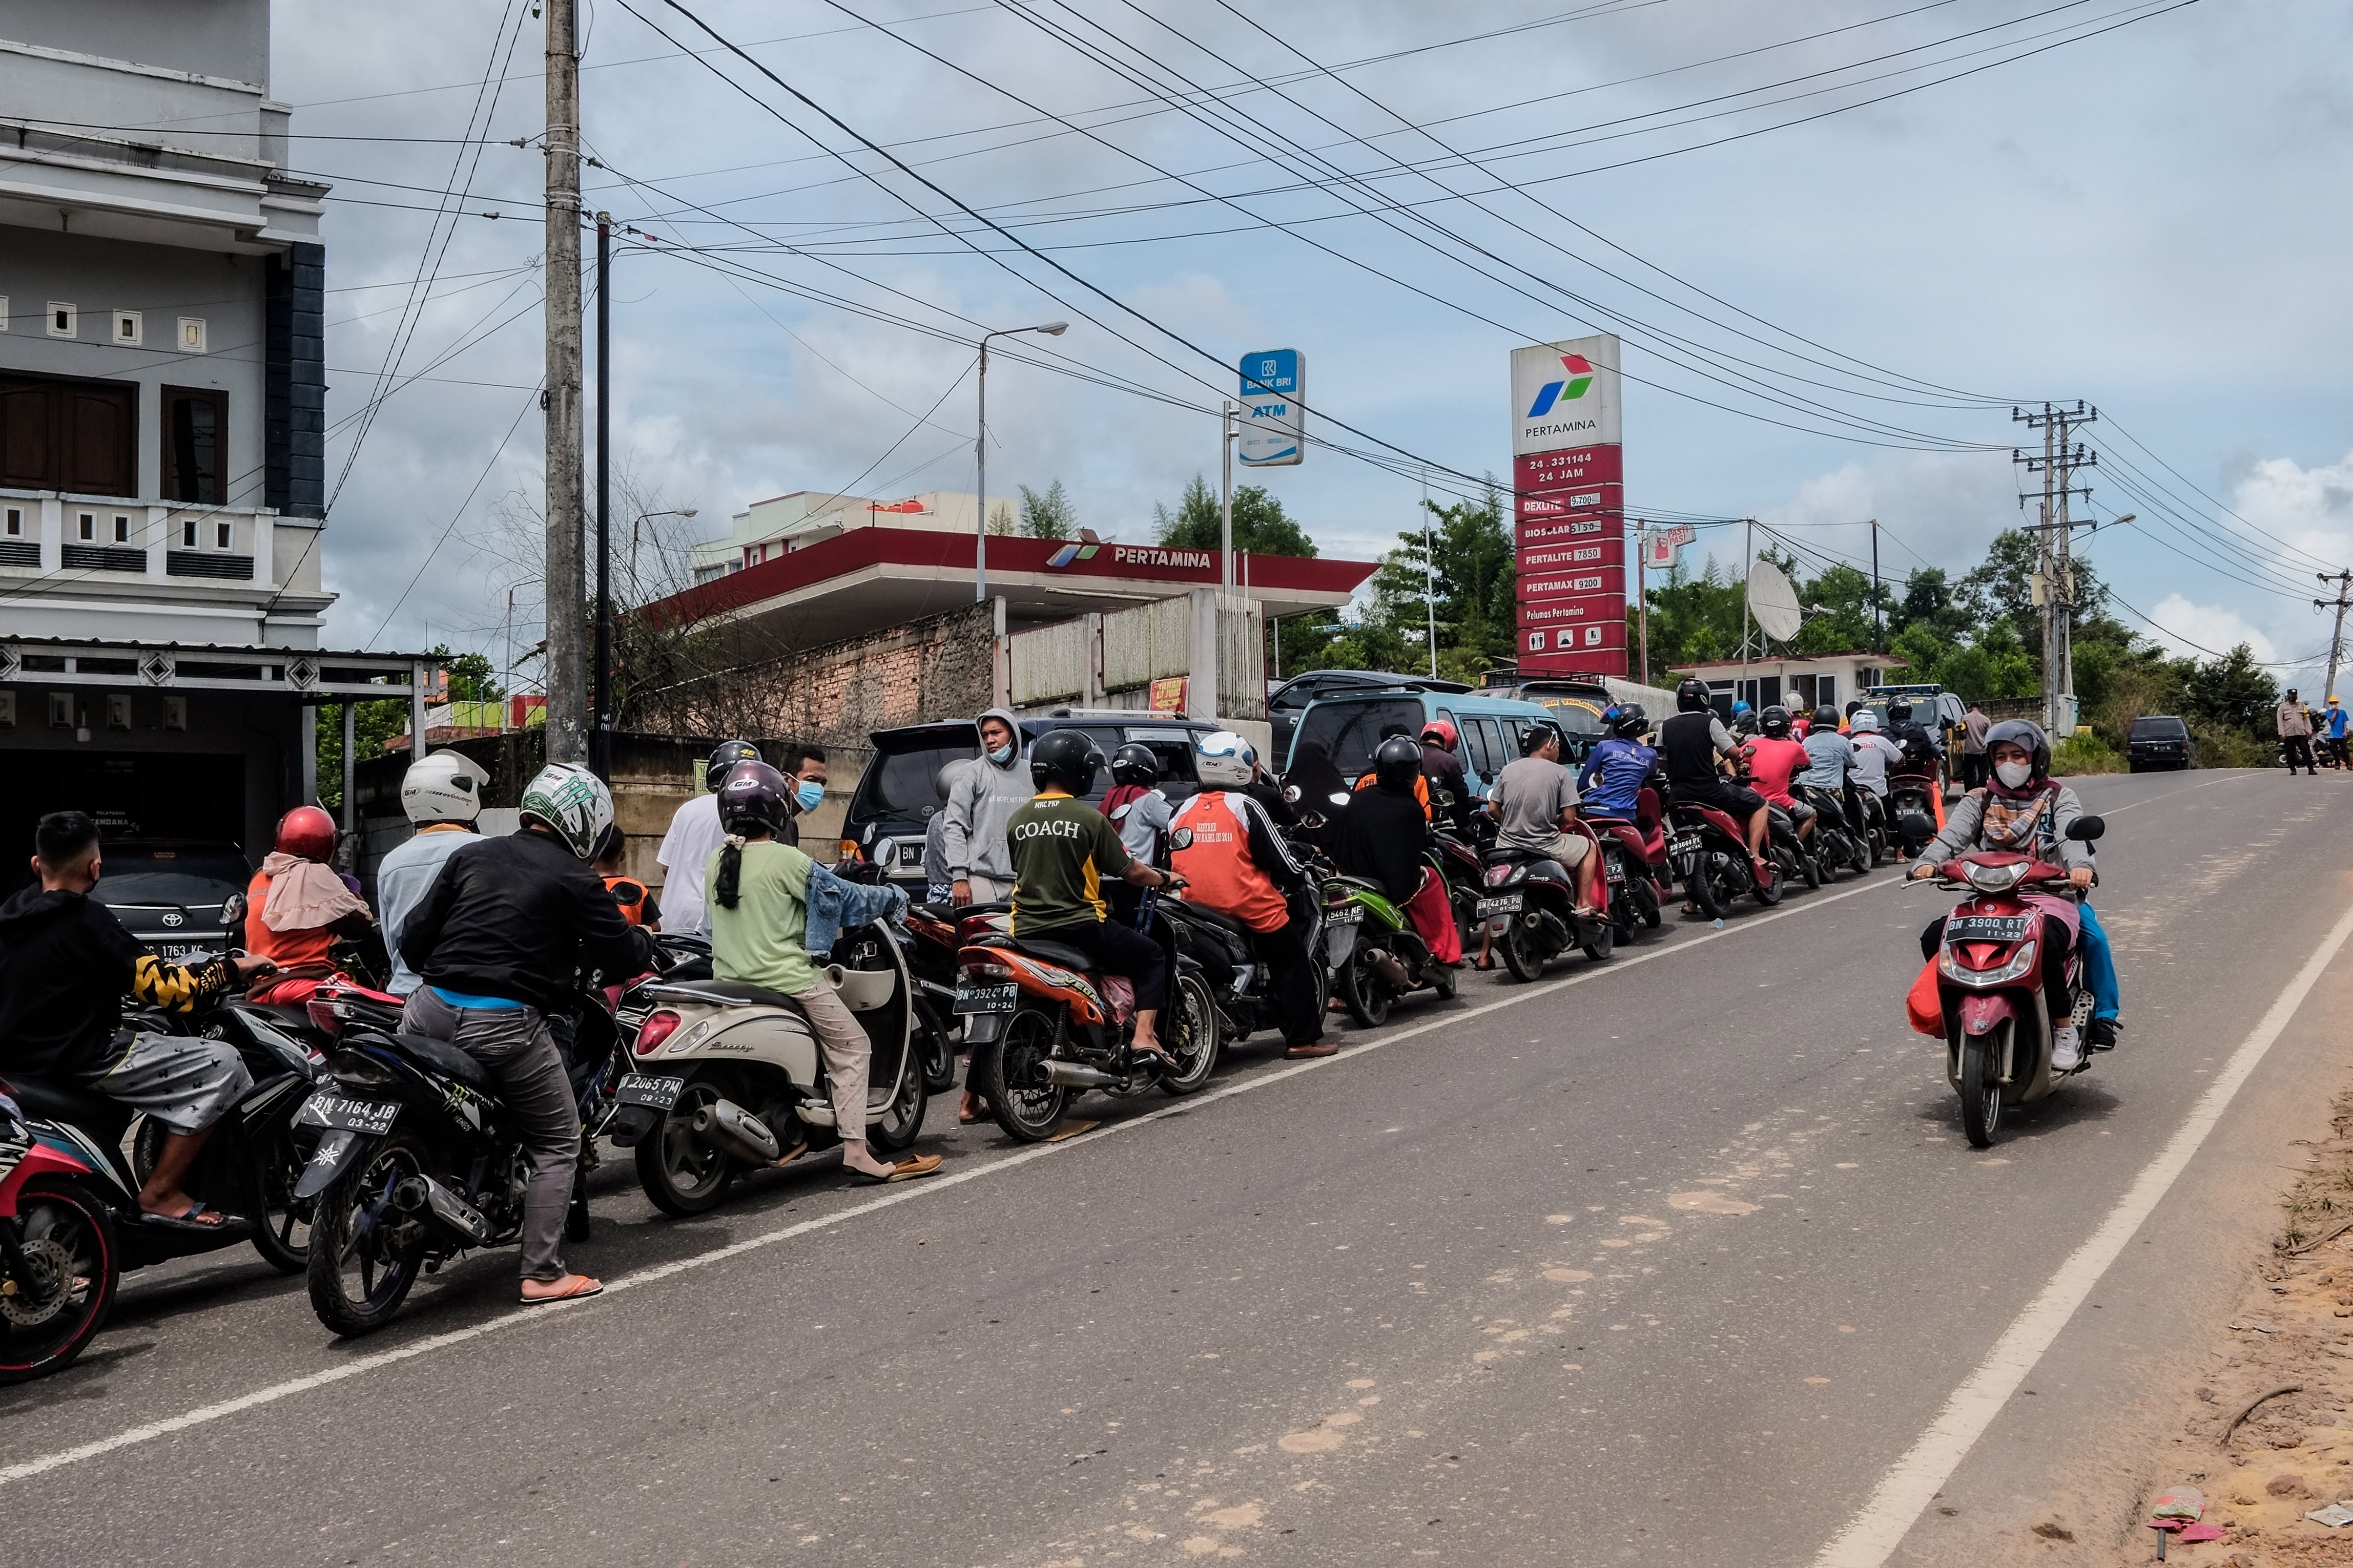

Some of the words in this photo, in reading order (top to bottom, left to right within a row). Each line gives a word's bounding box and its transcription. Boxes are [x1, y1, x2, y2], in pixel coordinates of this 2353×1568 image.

[1247, 378, 1274, 389] BANK
[1276, 377, 1291, 386] BRI
[1251, 404, 1286, 418] ATM
[1525, 420, 1596, 437] PERTAMINA
[1530, 453, 1592, 470] 24.331144
[1539, 472, 1554, 483] 24
[1559, 468, 1584, 479] JAM
[1524, 500, 1561, 512] DEXLITE
[1572, 495, 1592, 505] 9.700
[1571, 522, 1594, 533] 5150
[1114, 547, 1211, 568] PERTAMINA
[1526, 552, 1572, 565] PERTALITE
[1578, 549, 1598, 559] 7850
[1526, 580, 1573, 592] PERTAMAX
[1579, 579, 1598, 588] 9200
[1526, 610, 1552, 620] Pelumas
[1553, 605, 1584, 617] Pertamina
[1613, 750, 1649, 768] ITALIA
[544, 773, 563, 781] GM
[442, 791, 472, 803] evolution
[1034, 801, 1047, 809] MKC
[1015, 821, 1080, 841] COACH
[1196, 823, 1217, 831] REFEREE
[1193, 833, 1202, 843] ROV
[1201, 832, 1216, 843] BABEL
[1222, 832, 1233, 842] 2010
[903, 846, 914, 860] BN
[1611, 865, 1620, 873] PJ
[1490, 898, 1508, 907] 4276
[1330, 908, 1349, 918] 5462
[1351, 905, 1362, 915] NF
[1948, 919, 1963, 931] BN
[1968, 918, 2000, 928] 3900
[2006, 919, 2024, 929] RT
[162, 945, 186, 955] 1763
[957, 989, 970, 1000] BN
[974, 988, 997, 1000] 3924
[1064, 974, 1098, 1002] VEGA
[708, 1041, 755, 1052] Scoopy
[631, 1076, 662, 1091] 2065
[662, 1080, 680, 1094] PM
[314, 1096, 336, 1112] BN
[337, 1099, 373, 1117] 7164
[374, 1104, 396, 1119] JB
[456, 1117, 472, 1132] ENEOS
